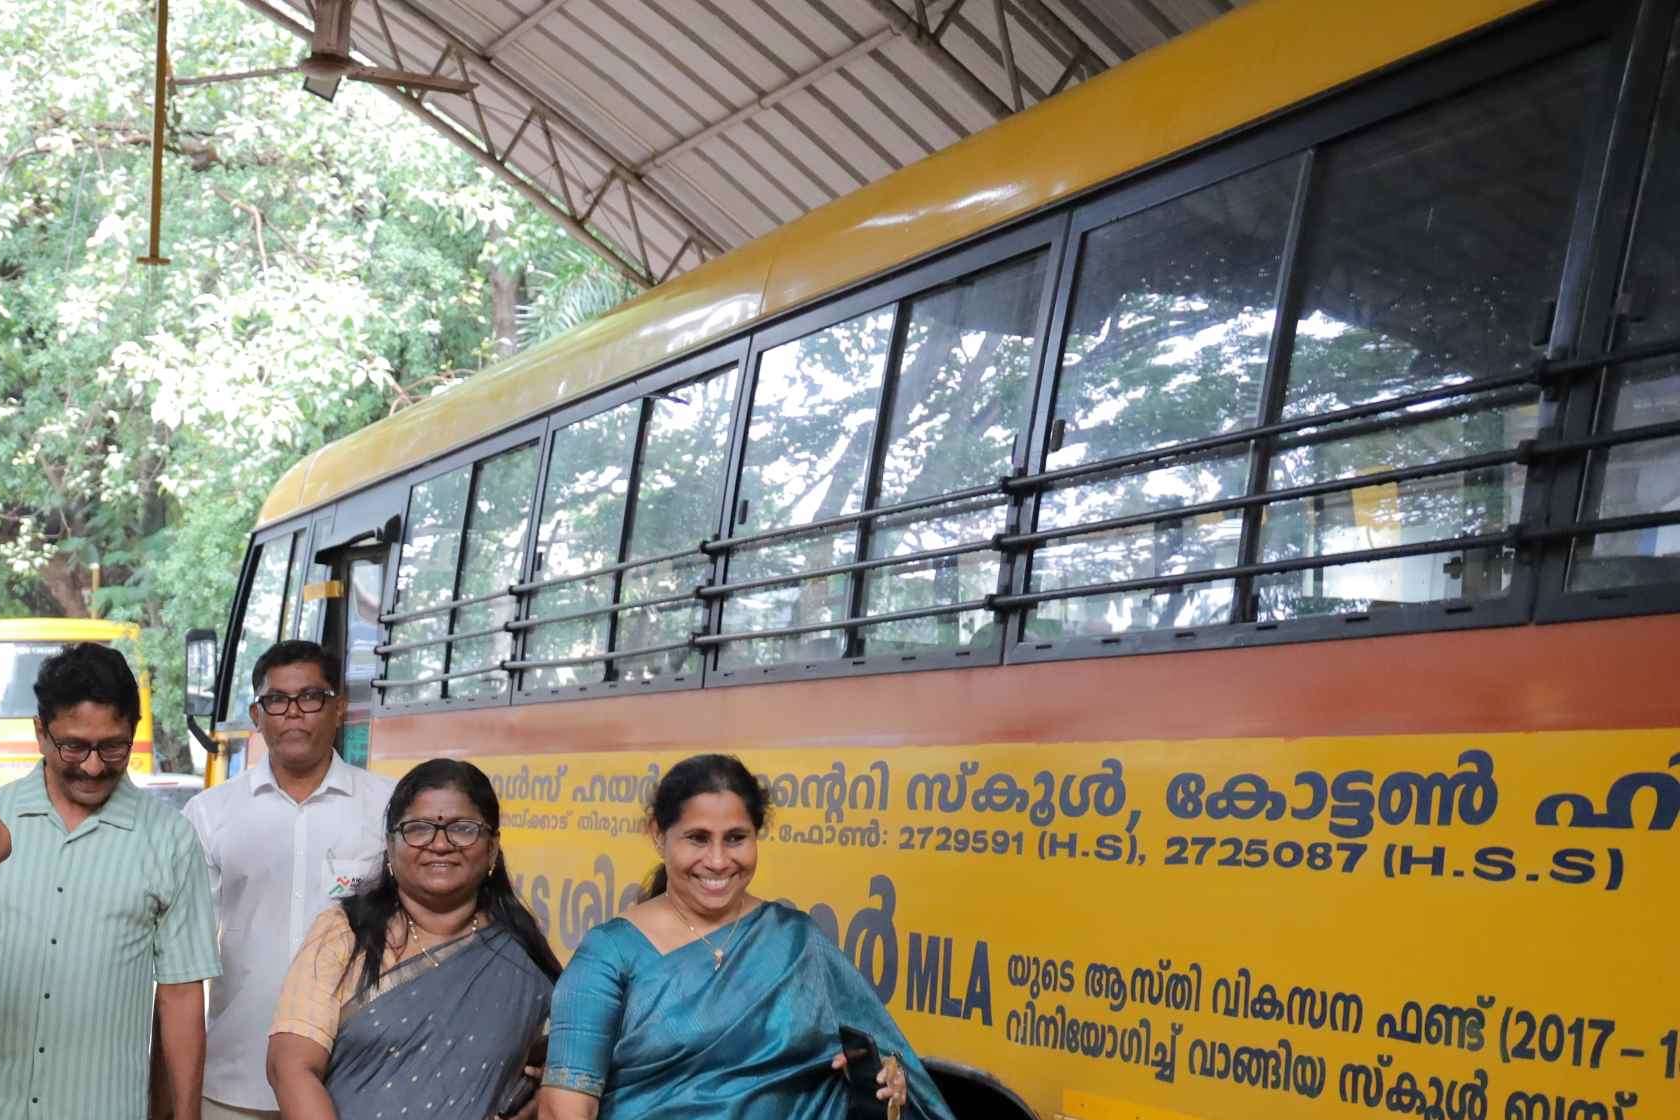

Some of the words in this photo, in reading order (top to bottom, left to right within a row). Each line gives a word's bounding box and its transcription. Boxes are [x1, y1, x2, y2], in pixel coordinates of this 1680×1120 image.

[899, 825, 1024, 855] 2729591
[1164, 836, 1368, 874] 2725087
[1383, 845, 1624, 890] (H.S.S)
[905, 932, 993, 1027] MLA
[1007, 953, 1075, 1000] യുടെ
[1084, 958, 1203, 1012] ആസ്തി
[1212, 967, 1363, 1033] വികസന
[1188, 1038, 1326, 1099] വാങ്ങിയ
